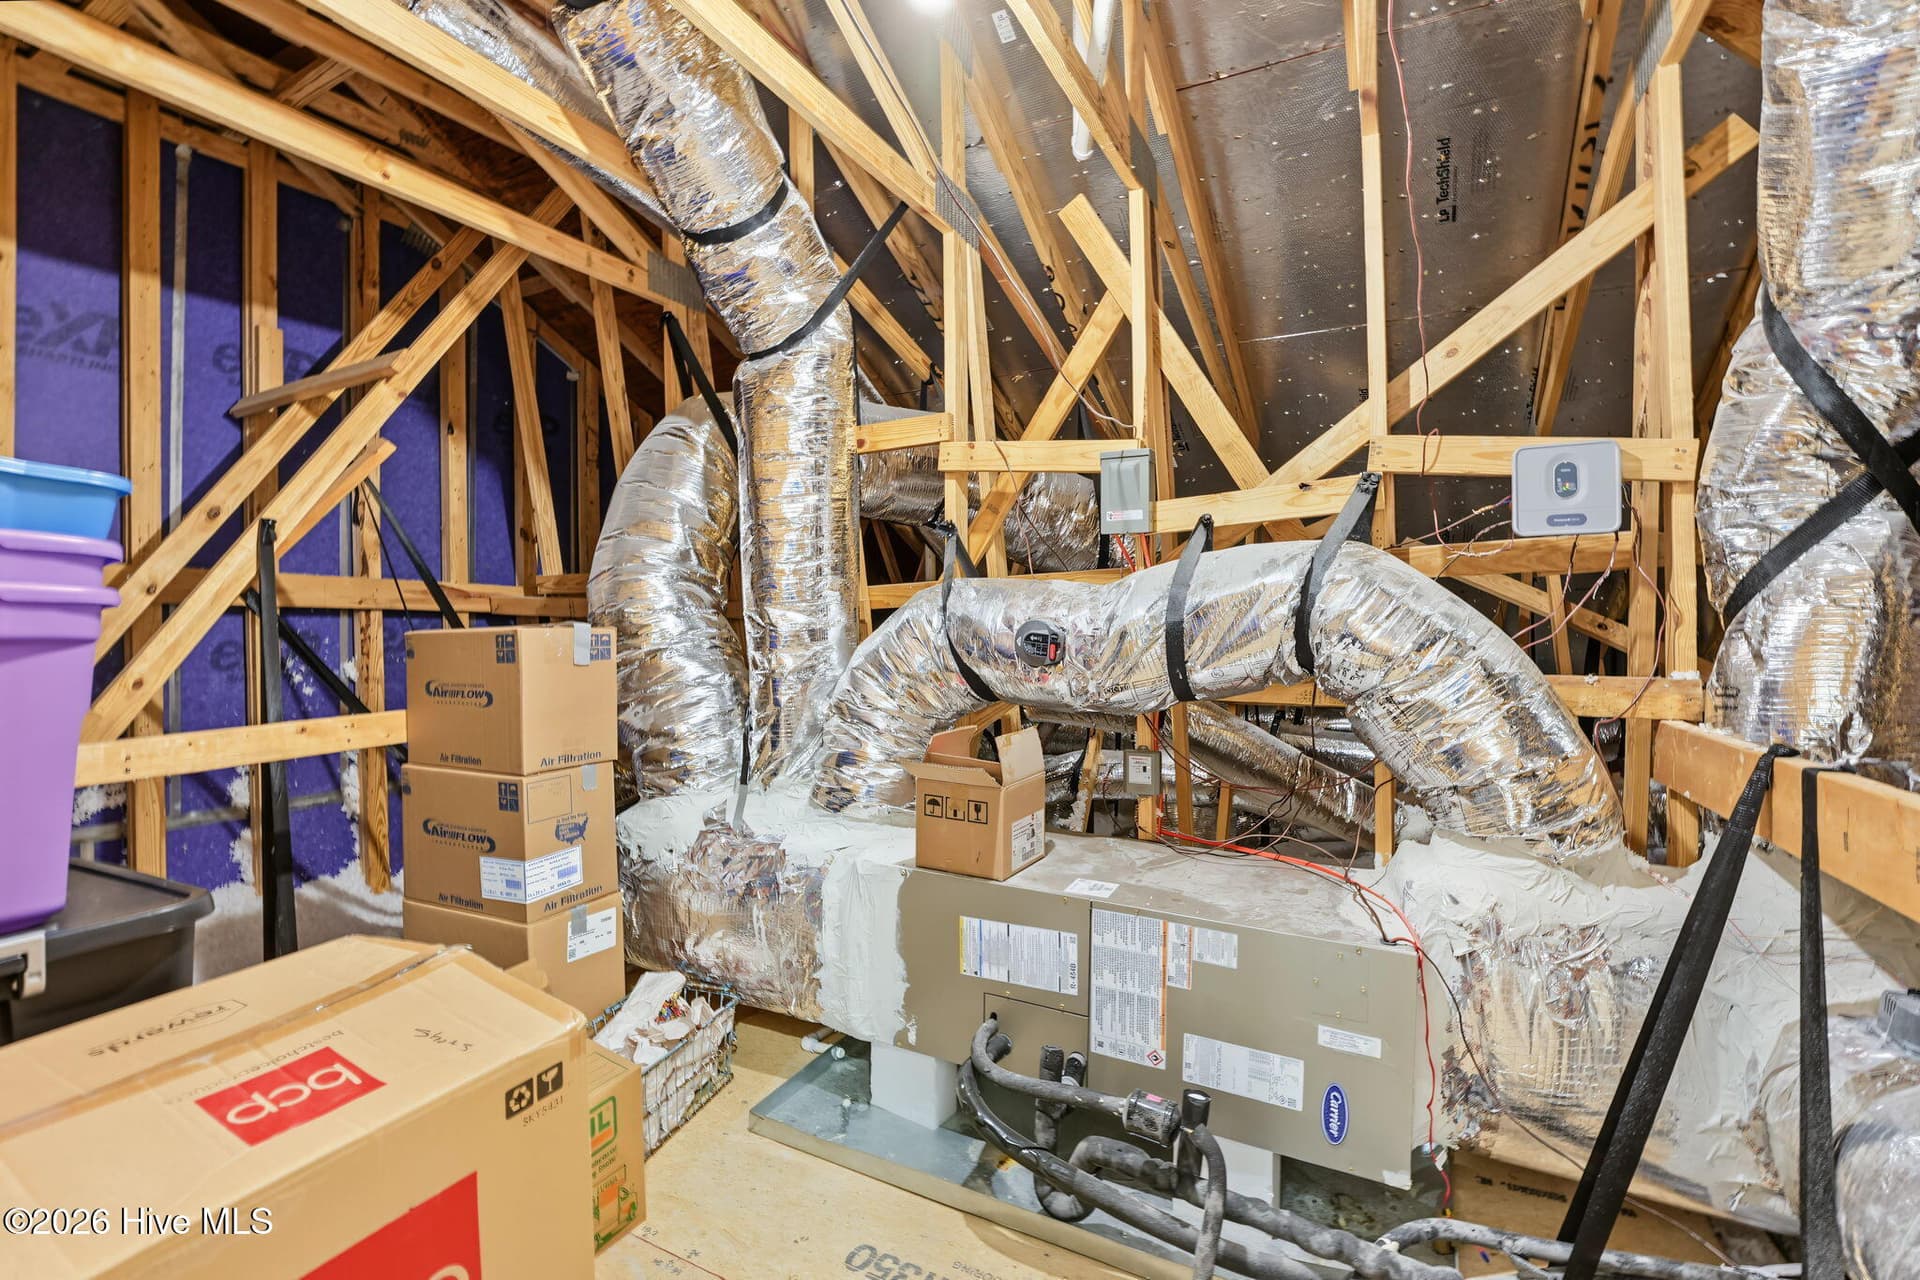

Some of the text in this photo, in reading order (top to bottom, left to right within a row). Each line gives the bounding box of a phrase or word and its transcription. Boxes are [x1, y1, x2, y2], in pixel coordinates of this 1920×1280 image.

[439, 752, 482, 766] Air Filtration
[540, 751, 601, 768] Air Filtration
[450, 894, 484, 912] Filtration
[543, 885, 603, 913] Air Filtration
[88, 1004, 230, 1057] rewards
[225, 1062, 363, 1125] bcp
[1328, 1091, 1343, 1138] Carrier
